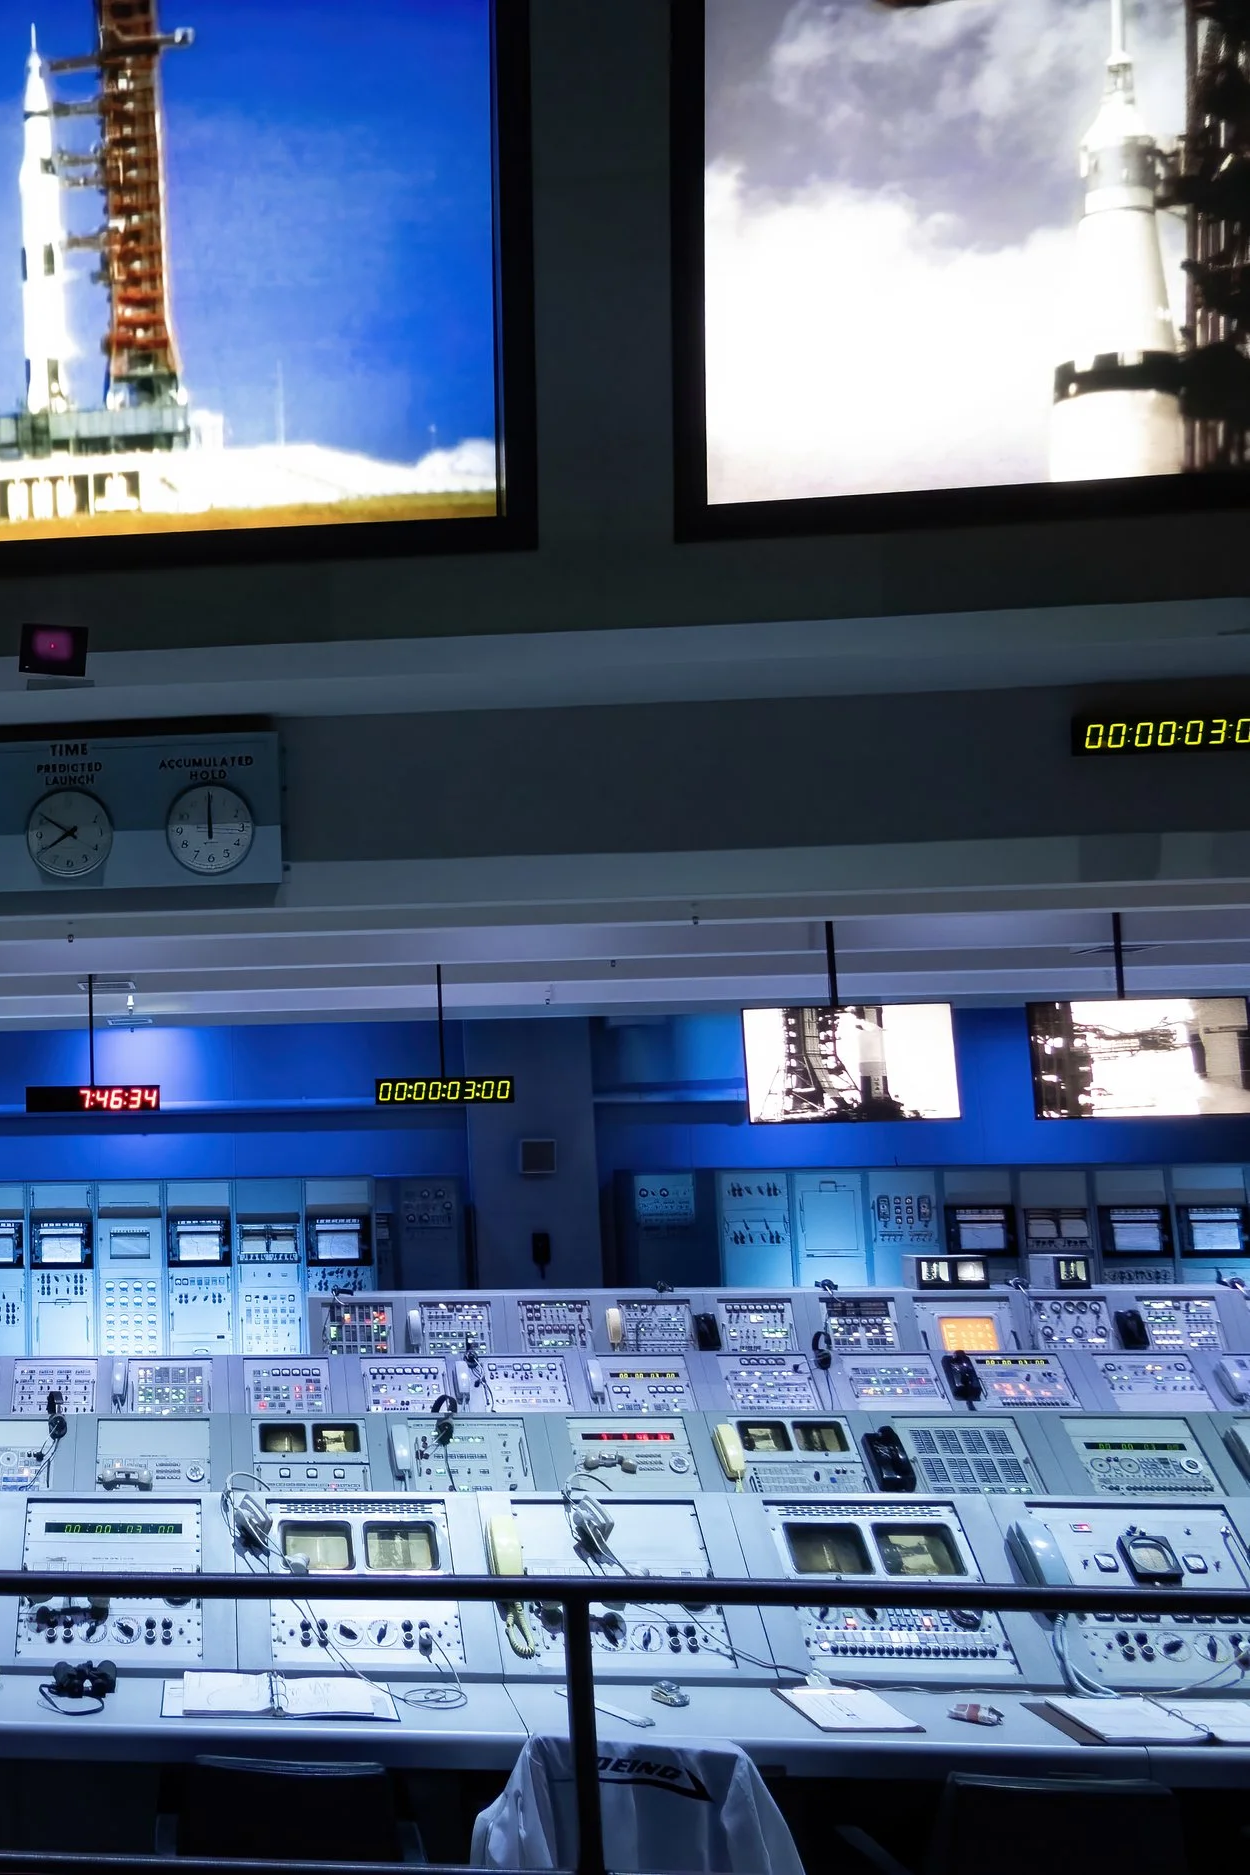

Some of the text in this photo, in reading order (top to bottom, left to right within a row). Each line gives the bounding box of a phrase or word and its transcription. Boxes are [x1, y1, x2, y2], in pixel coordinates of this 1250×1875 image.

[50, 743, 88, 757] TIME
[37, 762, 102, 773] PREDICTED
[159, 755, 254, 770] ACCUMULATED
[45, 774, 95, 786] LAUNCH
[189, 769, 226, 780] HOLD
[378, 1080, 511, 1101] 00:00:03:00
[79, 1089, 158, 1109] 7:46:34
[597, 1756, 682, 1780] OEING
